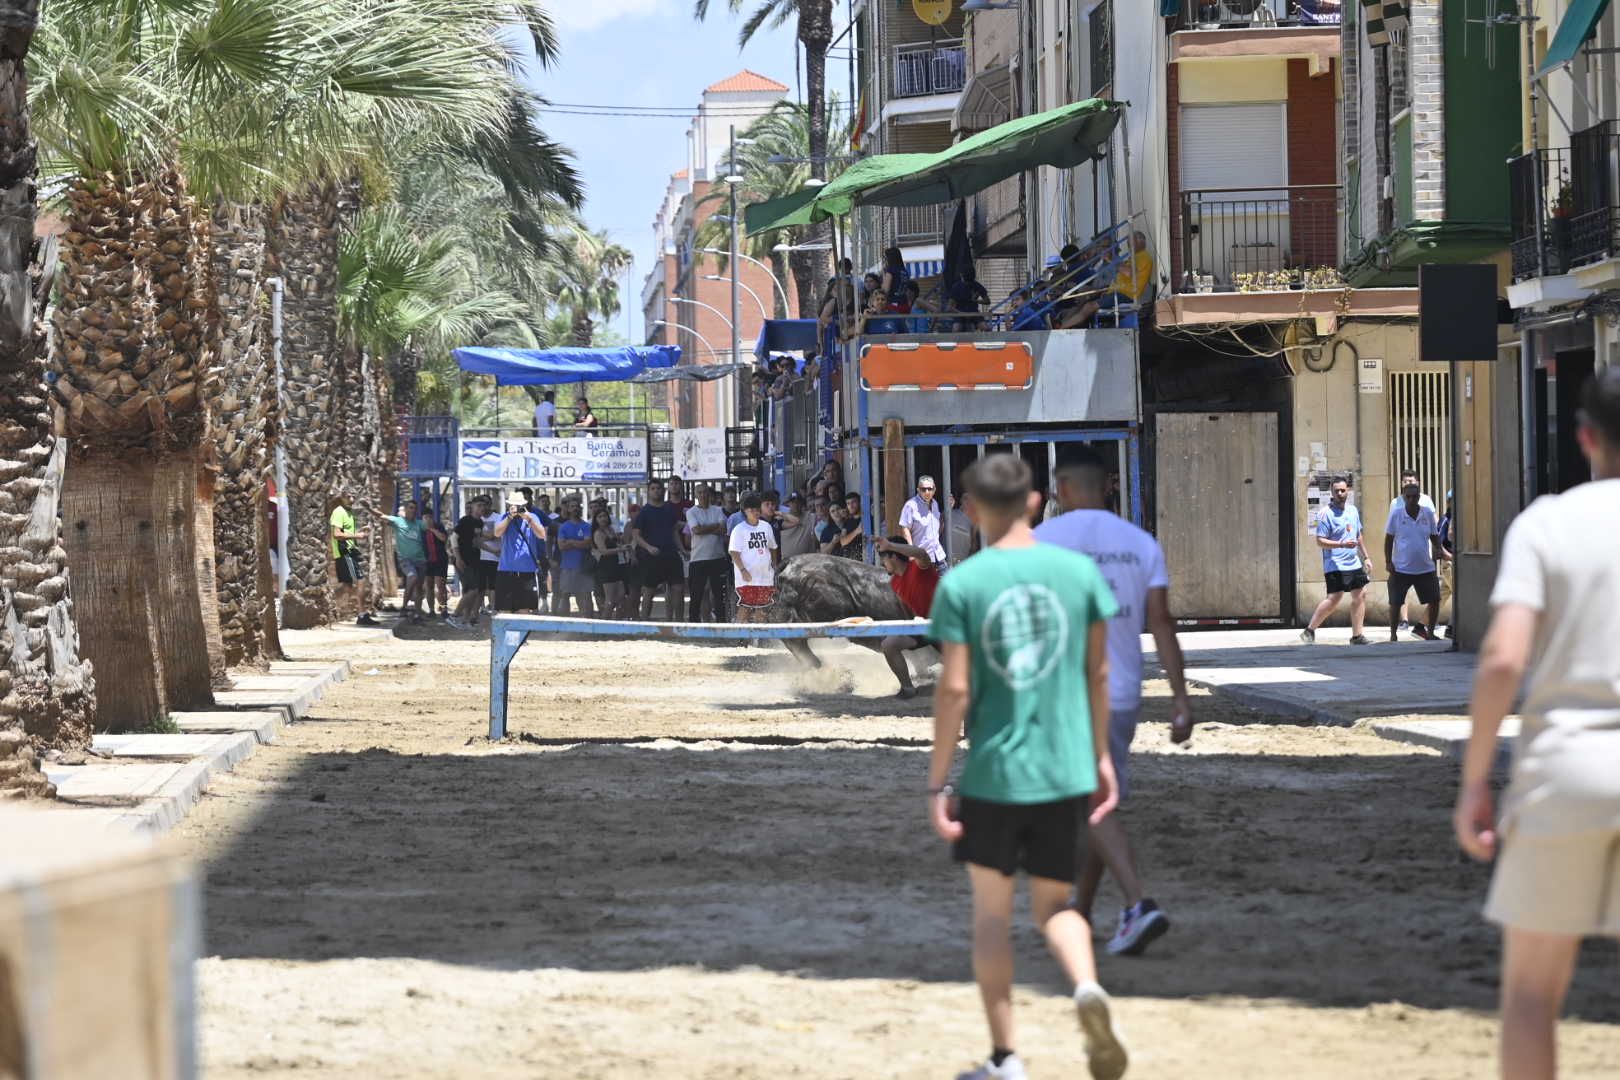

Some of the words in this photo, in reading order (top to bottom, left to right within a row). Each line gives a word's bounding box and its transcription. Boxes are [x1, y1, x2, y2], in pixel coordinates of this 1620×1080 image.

[504, 441, 524, 454] La
[525, 441, 577, 454] Tienda
[587, 440, 613, 450] Baño
[616, 440, 624, 450] &
[503, 467, 520, 479] del
[524, 456, 576, 479] Baño
[750, 532, 766, 540] JUST
[748, 541, 760, 549] DO
[761, 540, 767, 548] IT
